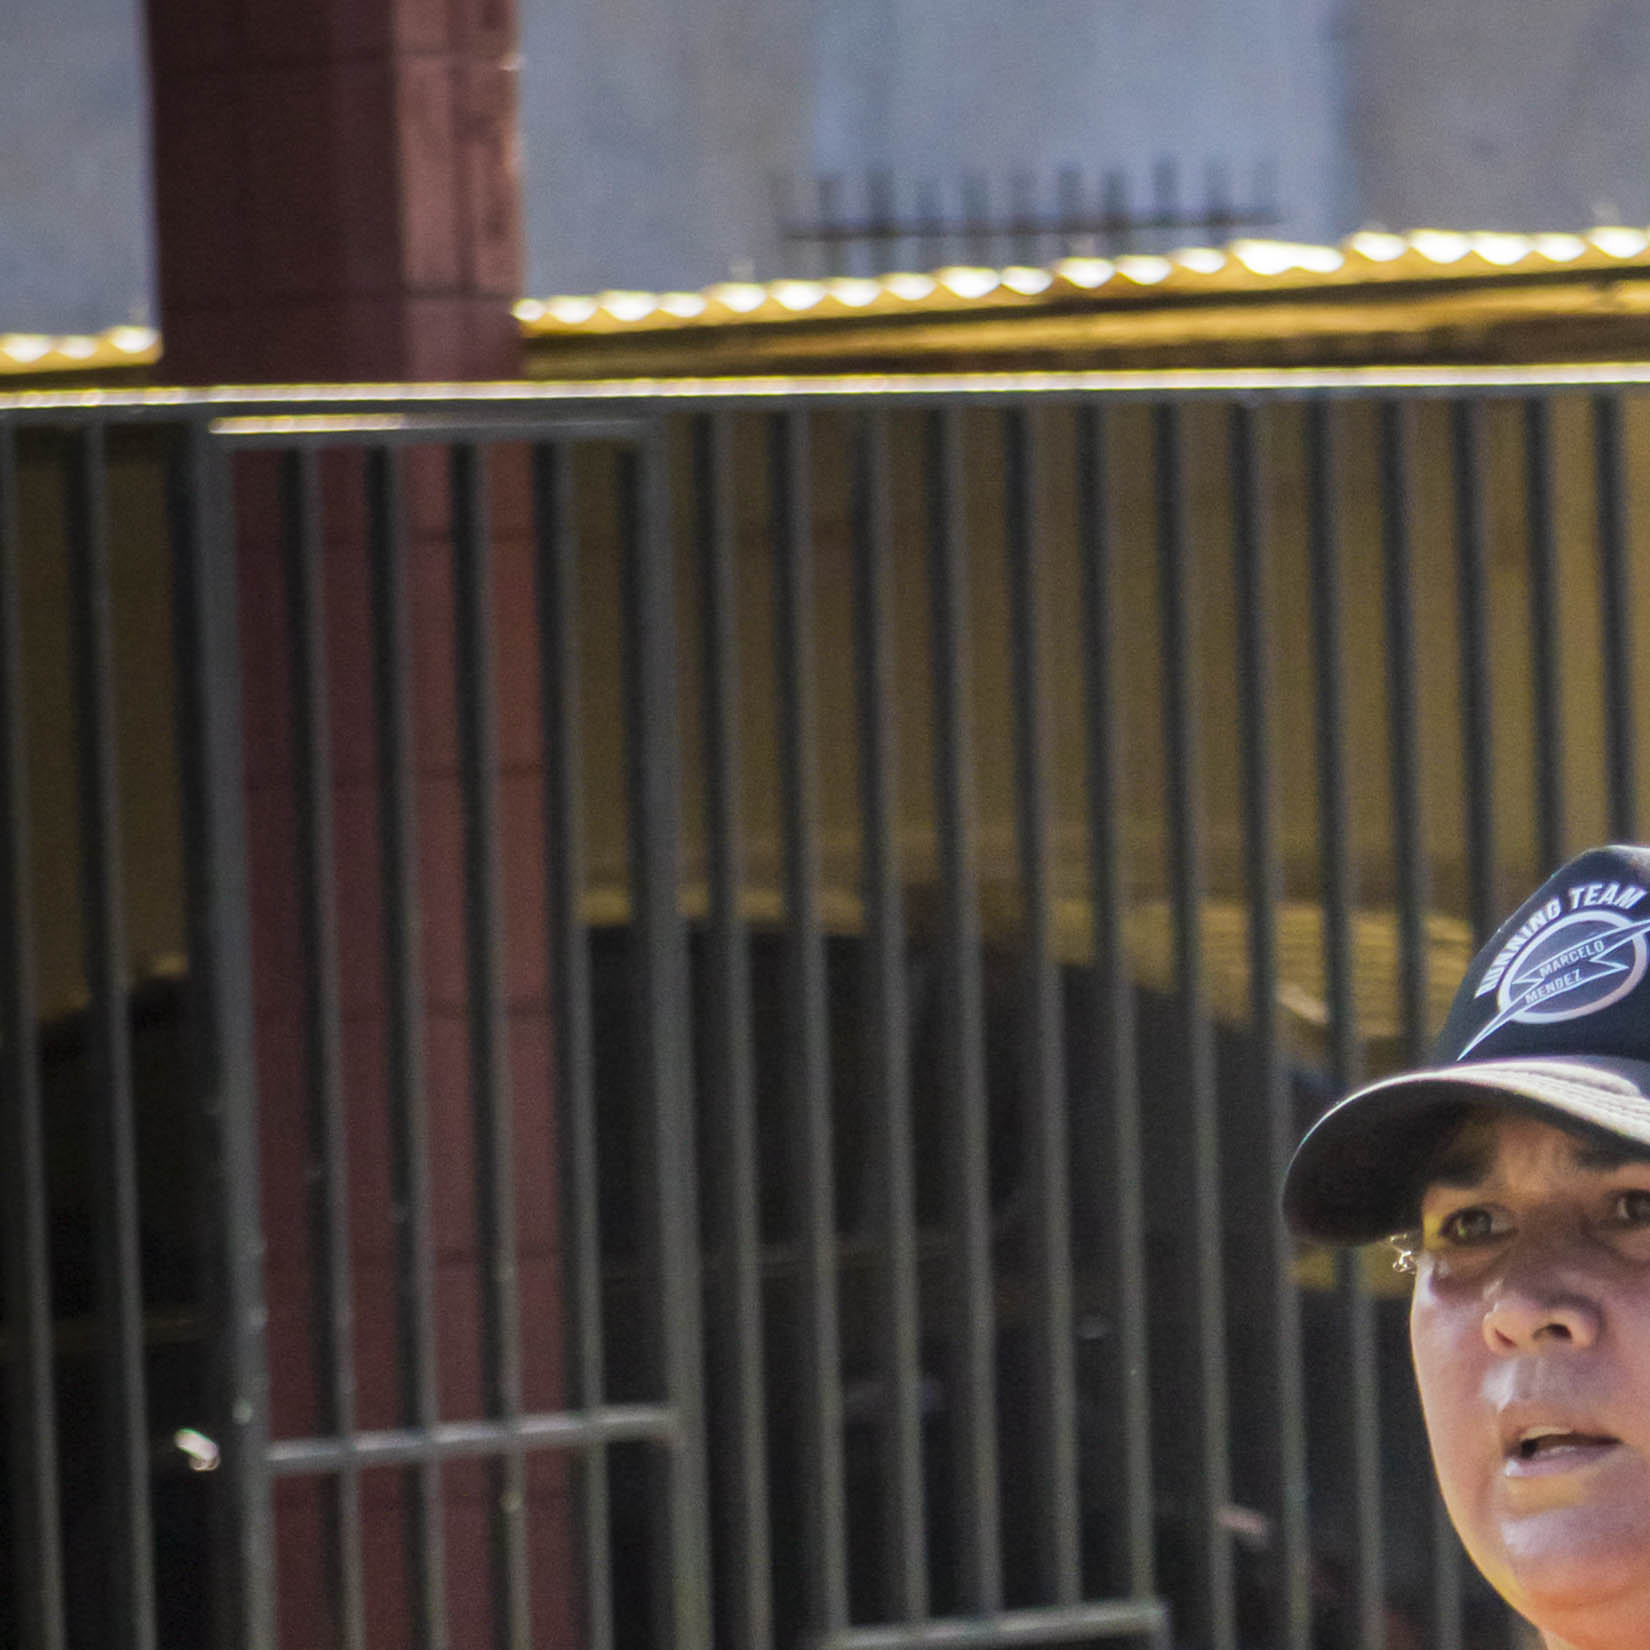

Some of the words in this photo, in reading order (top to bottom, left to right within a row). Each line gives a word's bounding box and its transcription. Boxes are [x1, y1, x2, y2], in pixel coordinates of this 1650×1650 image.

[1568, 881, 1648, 909] TEAM
[1540, 940, 1605, 977] MARCELO
[1524, 968, 1582, 1003] MENDEZ
